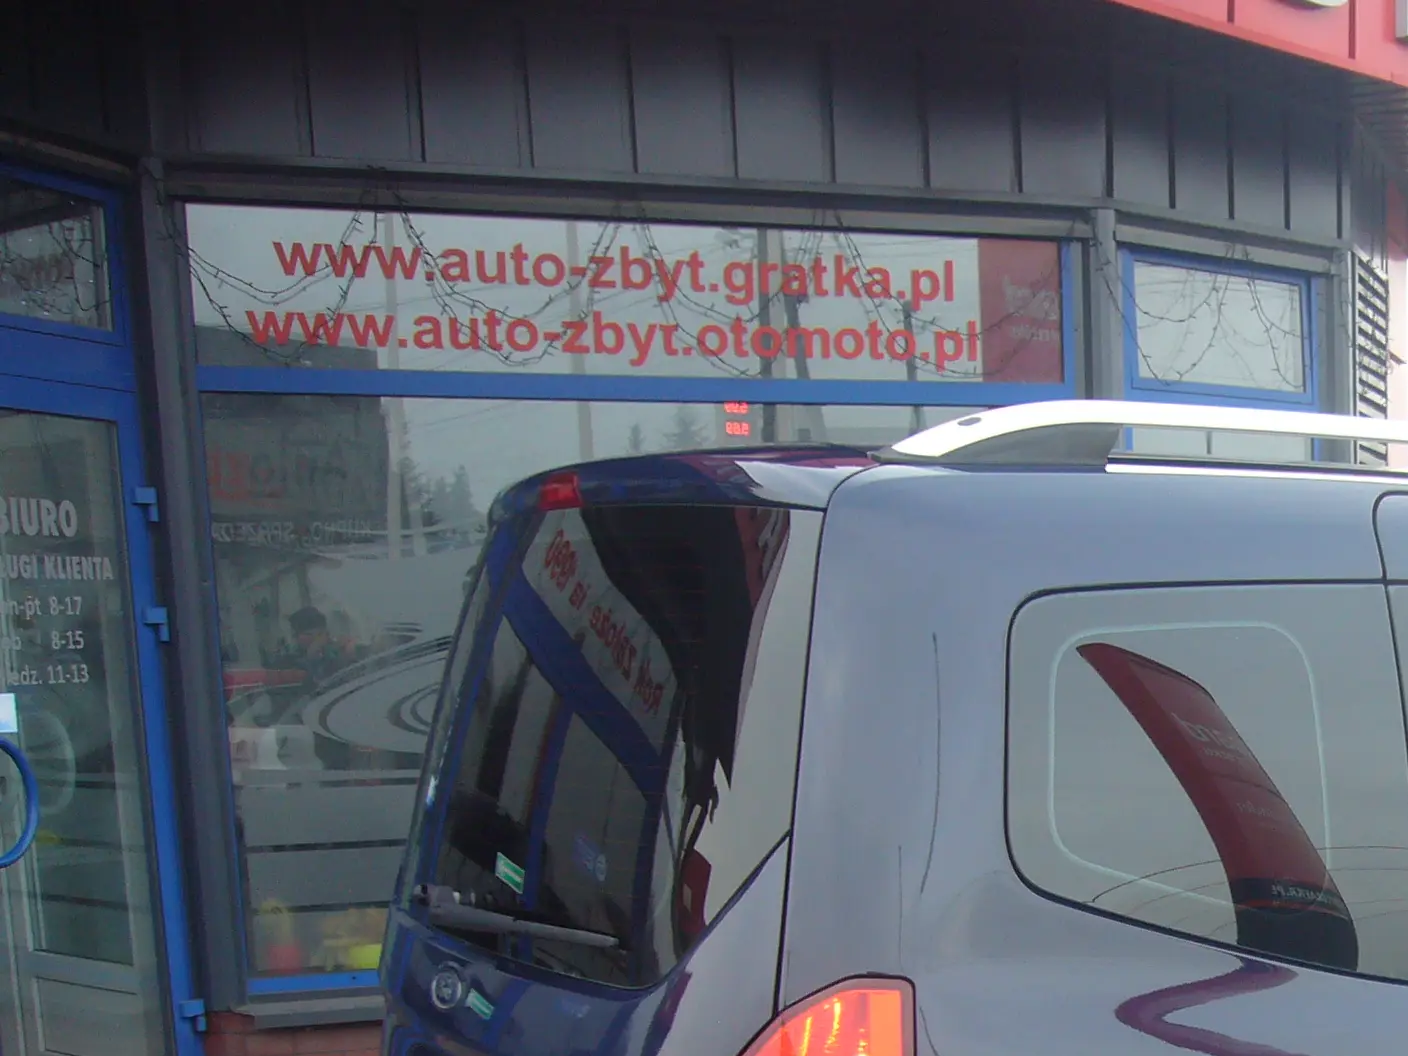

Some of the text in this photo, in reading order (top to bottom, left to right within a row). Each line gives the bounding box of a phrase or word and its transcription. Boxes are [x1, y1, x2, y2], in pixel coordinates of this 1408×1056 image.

[272, 241, 955, 312] www.auto-zbyt.gratka.pl
[245, 310, 979, 373] www.auto-zbyt.otomoto.pl
[44, 557, 114, 580] KLIENTA
[50, 596, 82, 615] 8-17
[51, 630, 84, 650] 8-15
[47, 664, 89, 684] 11-13
